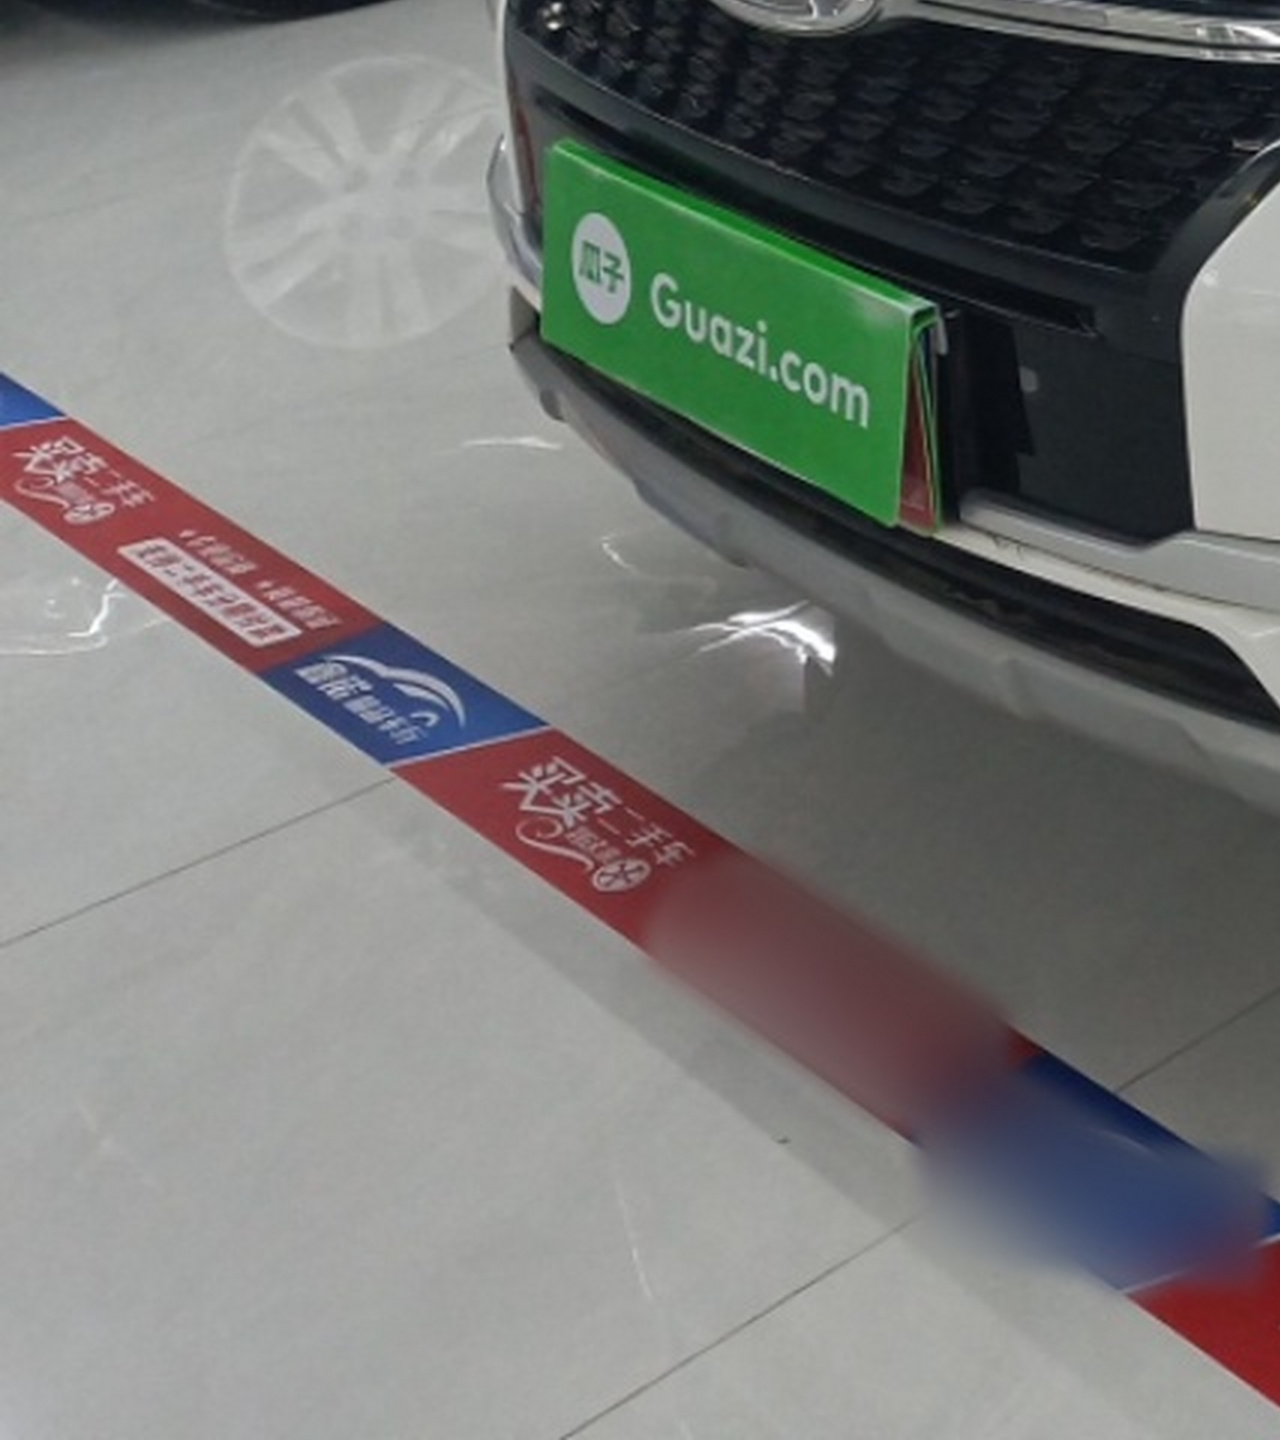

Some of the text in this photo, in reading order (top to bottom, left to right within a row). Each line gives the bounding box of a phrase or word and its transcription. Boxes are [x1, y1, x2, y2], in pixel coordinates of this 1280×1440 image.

[578, 238, 625, 294] 瓜子
[649, 273, 871, 428] Guazi.com
[11, 435, 155, 508] 买卖二手车
[499, 755, 697, 869] 买卖二手车
